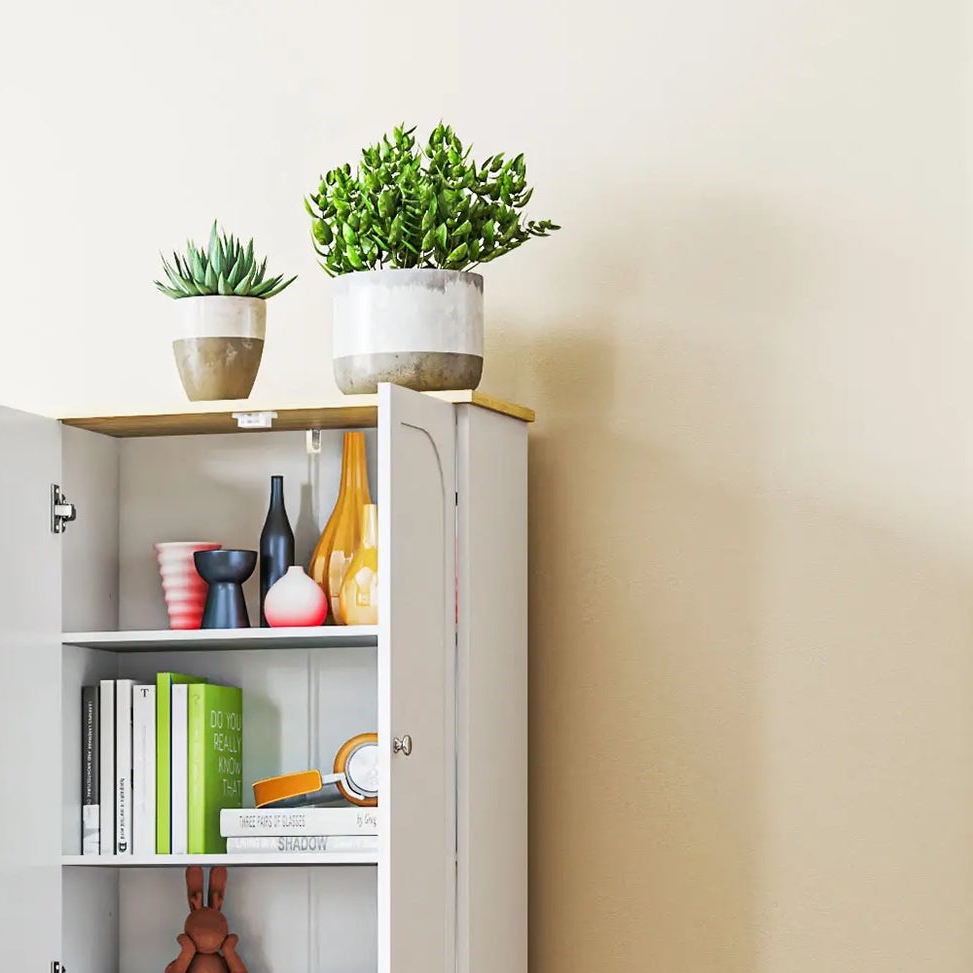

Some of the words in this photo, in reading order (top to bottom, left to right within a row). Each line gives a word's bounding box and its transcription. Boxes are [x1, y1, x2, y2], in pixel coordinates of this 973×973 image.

[140, 688, 149, 698] T
[210, 710, 223, 729] DO
[227, 712, 242, 731] YOU
[213, 732, 242, 753] REALLY
[218, 756, 241, 775] KNOW
[222, 778, 241, 798] THAT
[239, 815, 256, 828] THREE
[118, 842, 127, 853] D
[277, 837, 329, 851] SHADOW
